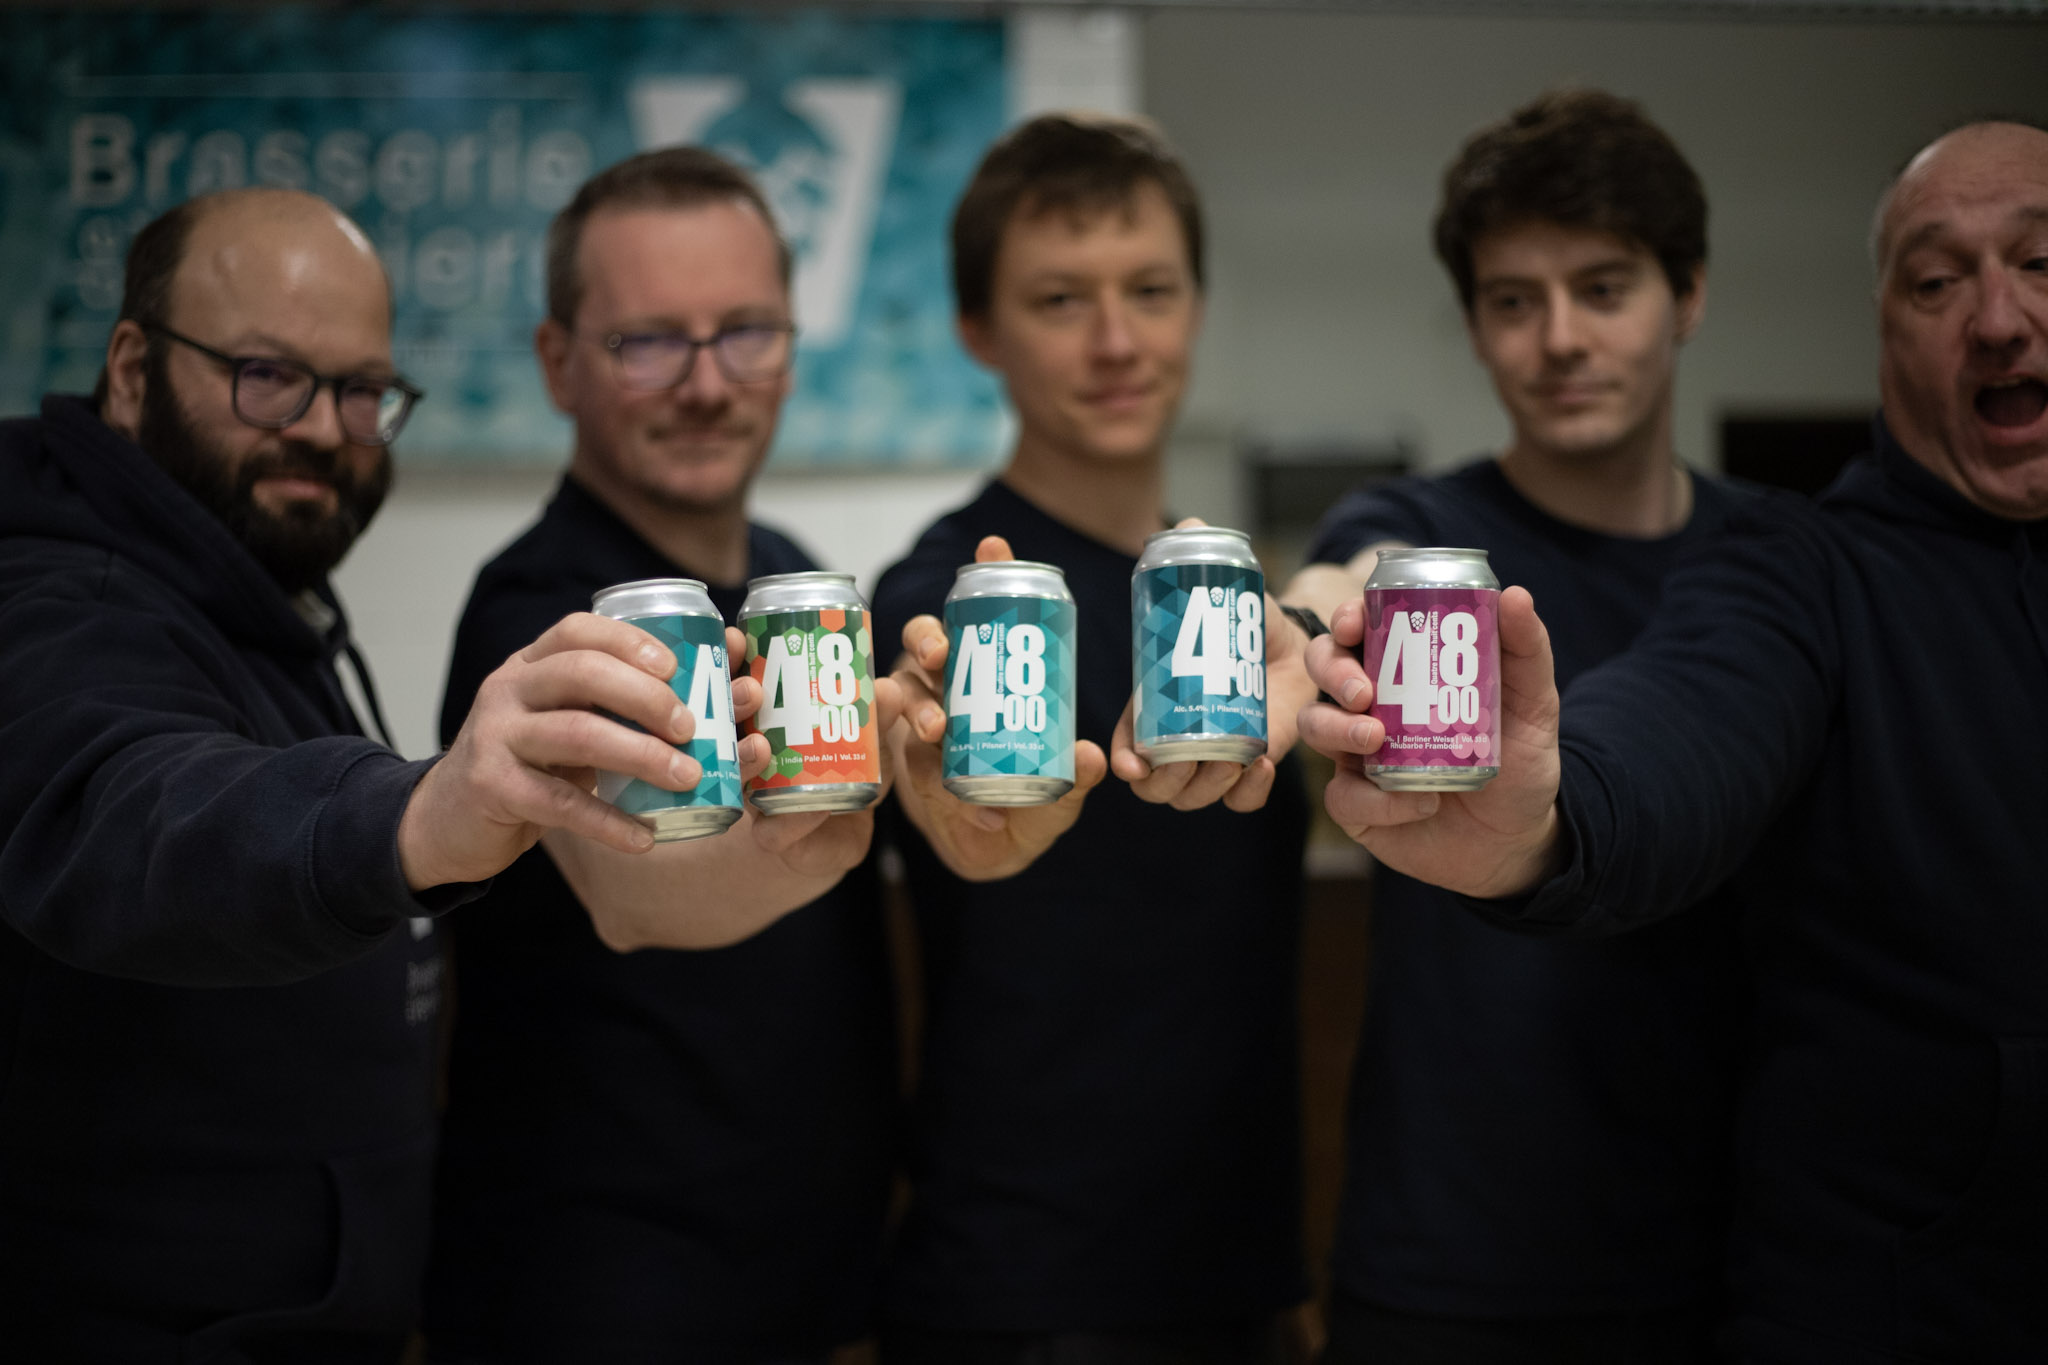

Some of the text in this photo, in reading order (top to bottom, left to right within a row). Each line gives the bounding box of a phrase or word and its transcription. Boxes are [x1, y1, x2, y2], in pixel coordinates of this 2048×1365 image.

[68, 109, 594, 210] Brasserie
[1431, 611, 1439, 685] Quatre mille huit cents
[1216, 705, 1240, 714] Pilsner
[1403, 735, 1432, 743] Berliner
[1433, 735, 1454, 743] Weiss
[981, 742, 1006, 750] Pilsner
[785, 755, 803, 764] India
